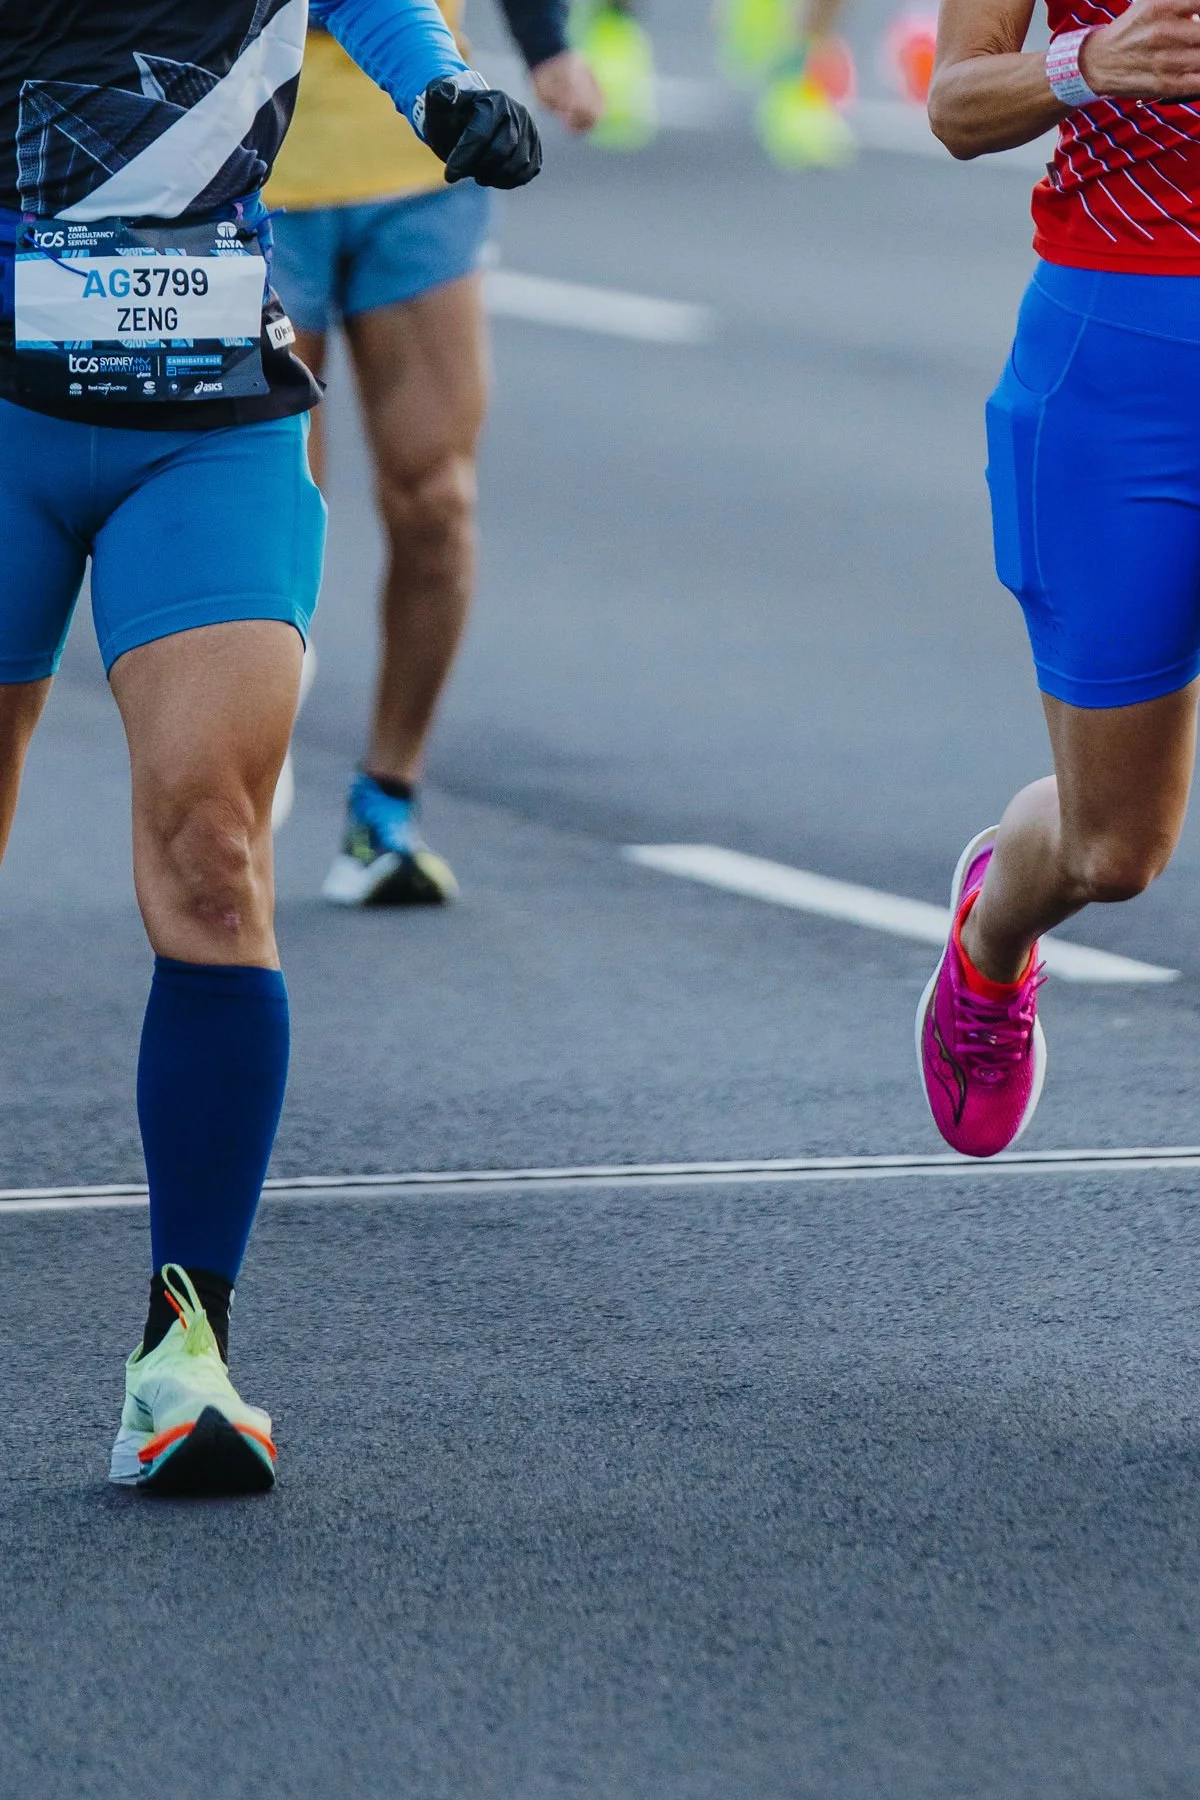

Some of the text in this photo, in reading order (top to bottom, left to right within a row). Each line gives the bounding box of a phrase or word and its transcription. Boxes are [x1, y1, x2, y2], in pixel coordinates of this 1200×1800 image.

[67, 225, 89, 233] TATA
[67, 231, 115, 240] CONSULTANCY
[67, 238, 98, 247] SERVICES
[215, 239, 244, 249] TATA
[82, 268, 208, 299] AG3799
[117, 307, 178, 332] ZENG
[69, 353, 99, 373] tcs
[100, 356, 134, 366] SYDNEY
[100, 364, 152, 372] MARATHON
[201, 382, 223, 392] asics
